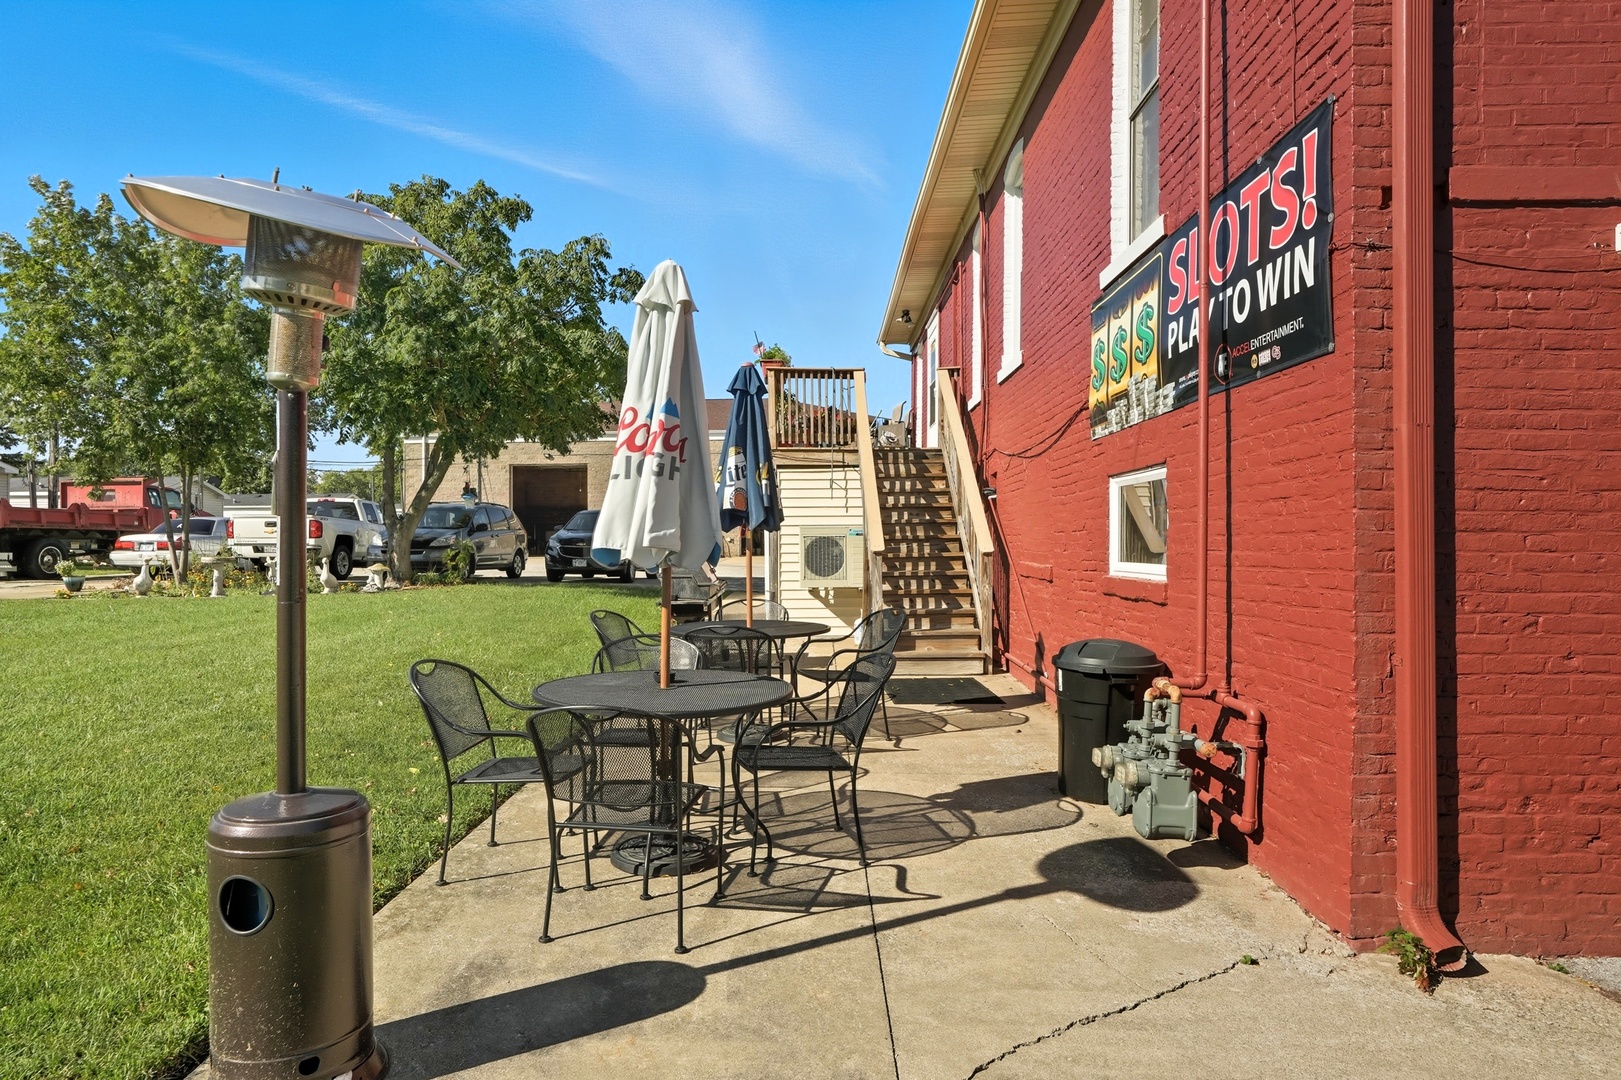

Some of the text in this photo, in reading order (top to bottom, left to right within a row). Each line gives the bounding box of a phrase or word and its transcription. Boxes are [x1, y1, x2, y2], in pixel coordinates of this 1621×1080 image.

[1167, 127, 1318, 315] SLOTS!
[1168, 236, 1315, 359] PLA TO WIN
